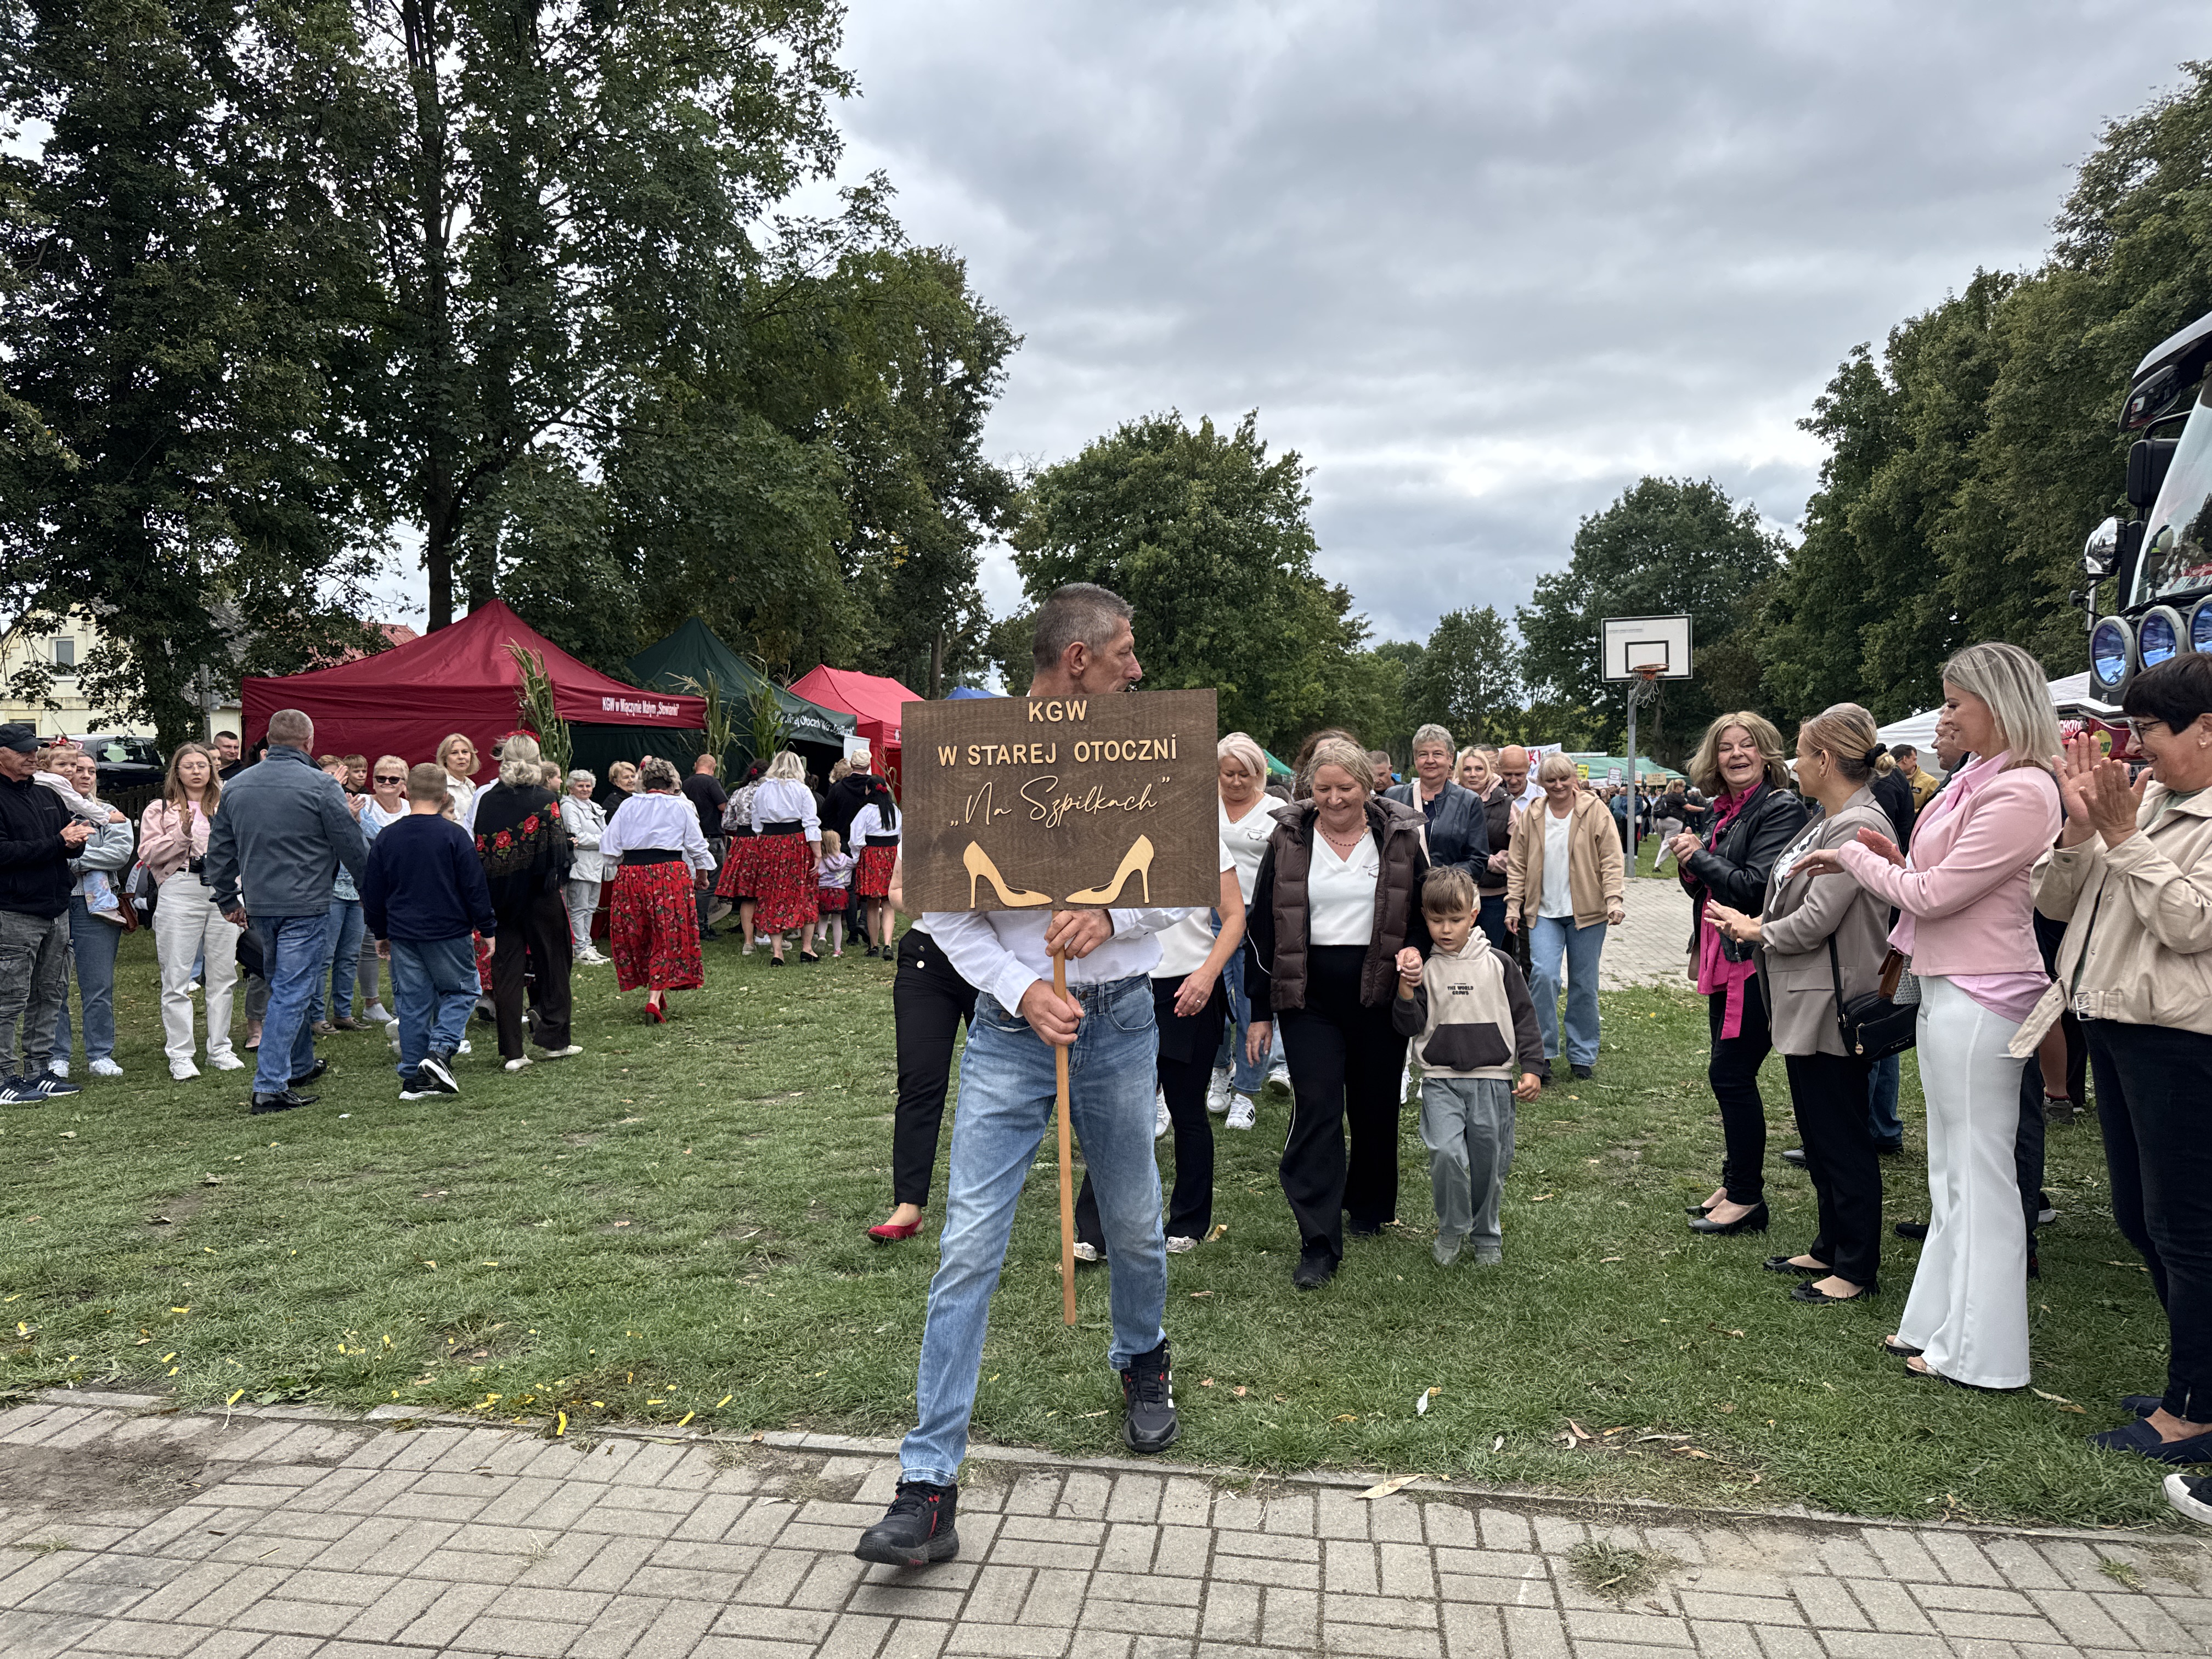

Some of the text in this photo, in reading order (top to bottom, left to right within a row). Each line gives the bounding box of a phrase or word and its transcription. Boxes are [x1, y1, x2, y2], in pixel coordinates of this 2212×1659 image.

[602, 697, 615, 712] KGW
[1029, 700, 1087, 723] KGW
[938, 745, 957, 766] W
[968, 742, 1056, 766] STAREJ
